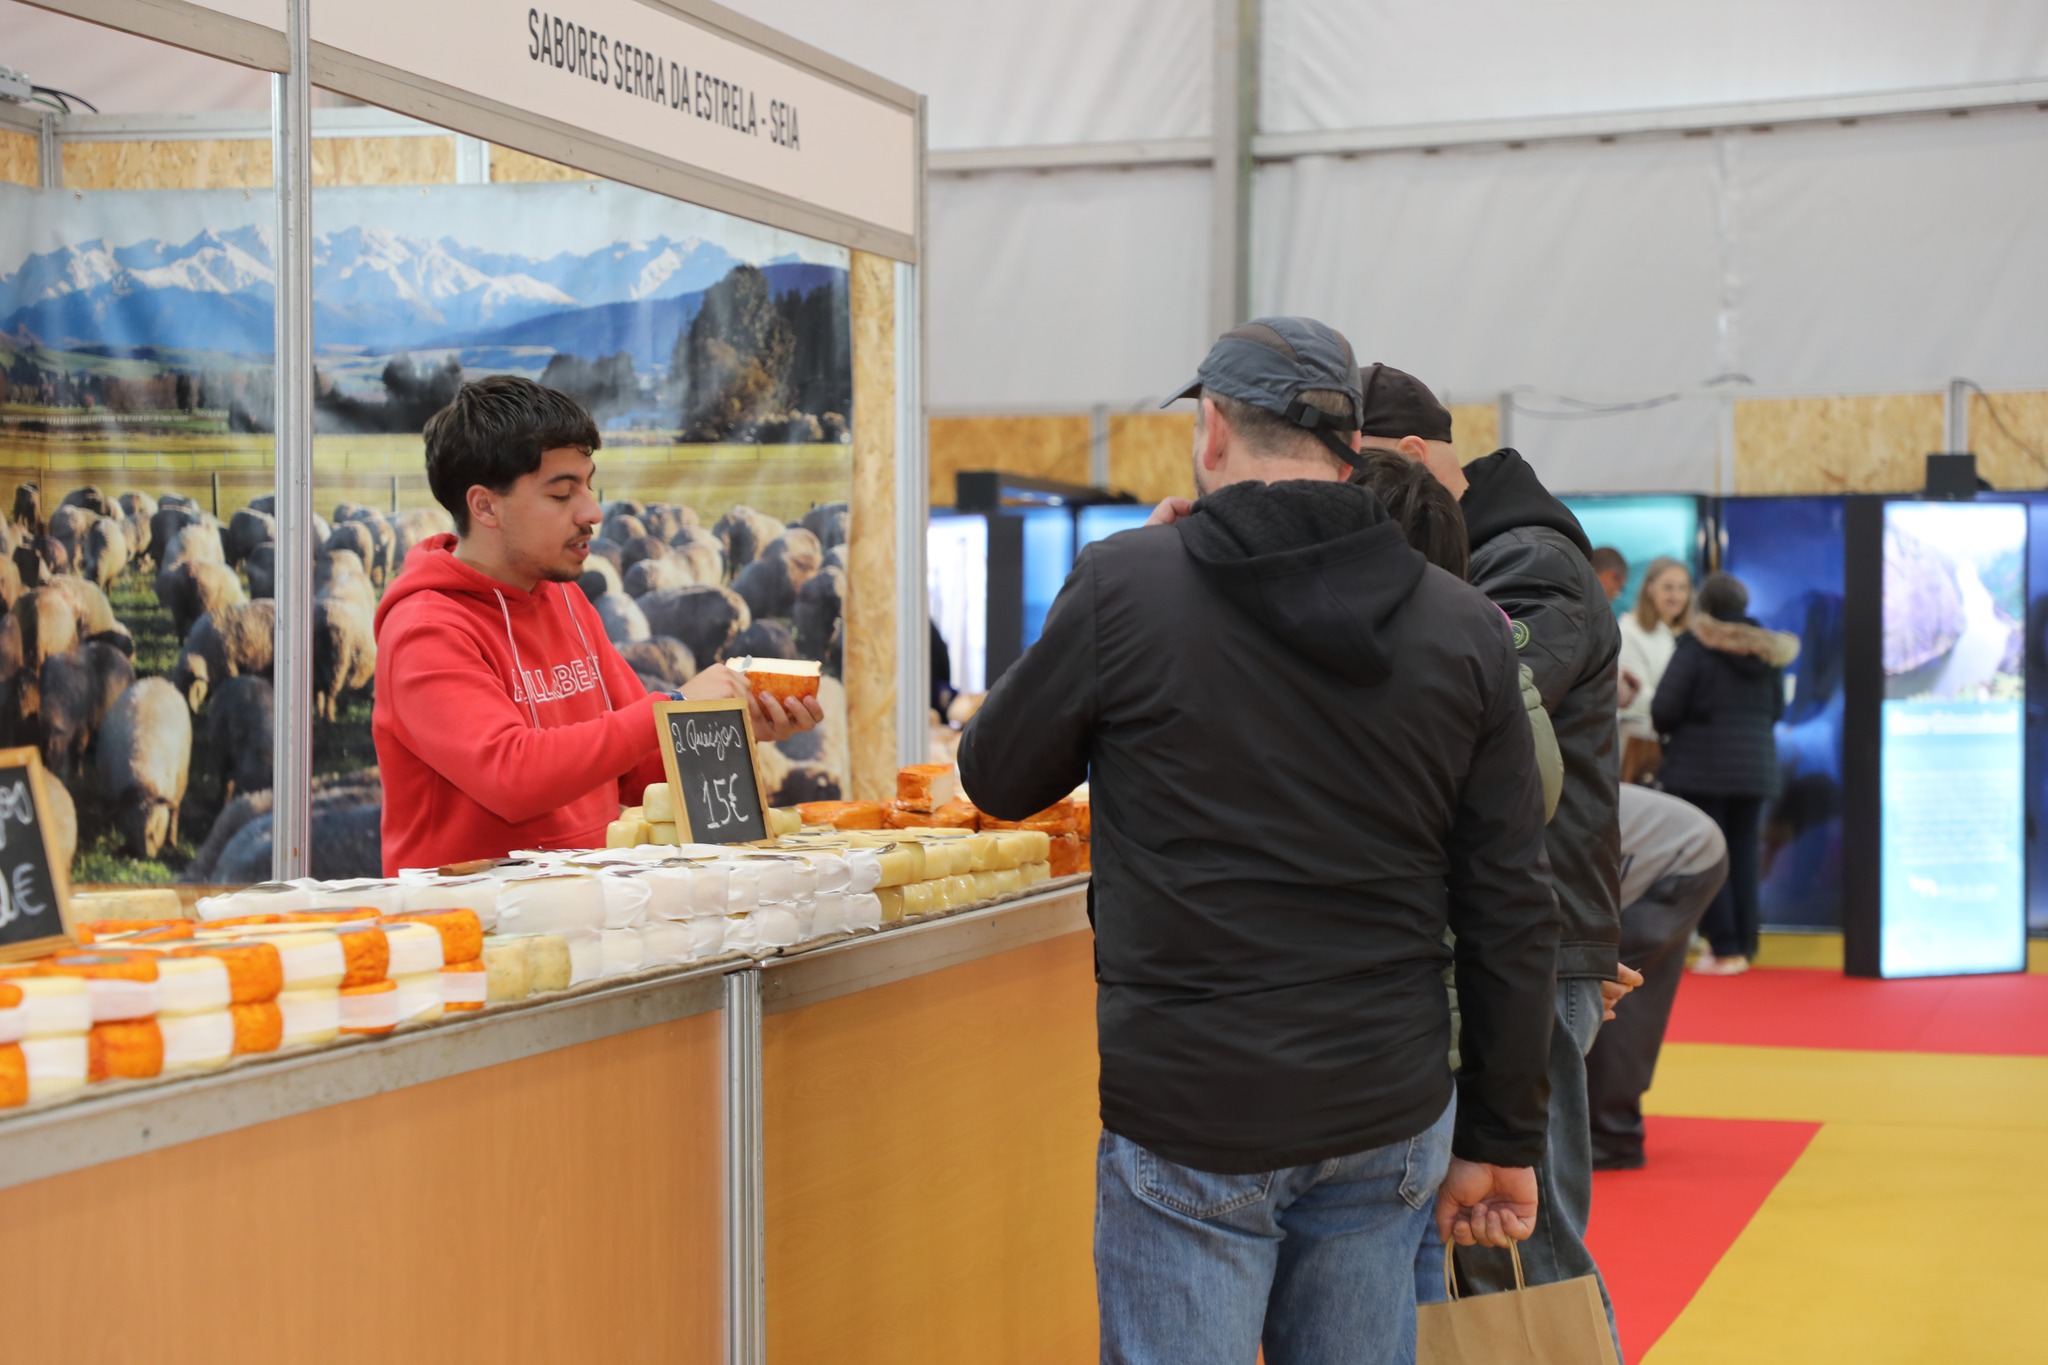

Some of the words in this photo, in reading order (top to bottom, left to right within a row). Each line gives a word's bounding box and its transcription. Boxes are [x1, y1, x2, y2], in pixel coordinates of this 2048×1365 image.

[528, 8, 609, 85] SABORES
[614, 41, 666, 106] SERRA
[670, 61, 692, 115] DA
[694, 70, 758, 137] ESTRELA
[769, 99, 801, 152] SEIA
[671, 722, 688, 754] 2
[685, 719, 742, 761] Queijos
[702, 772, 750, 829] 15€
